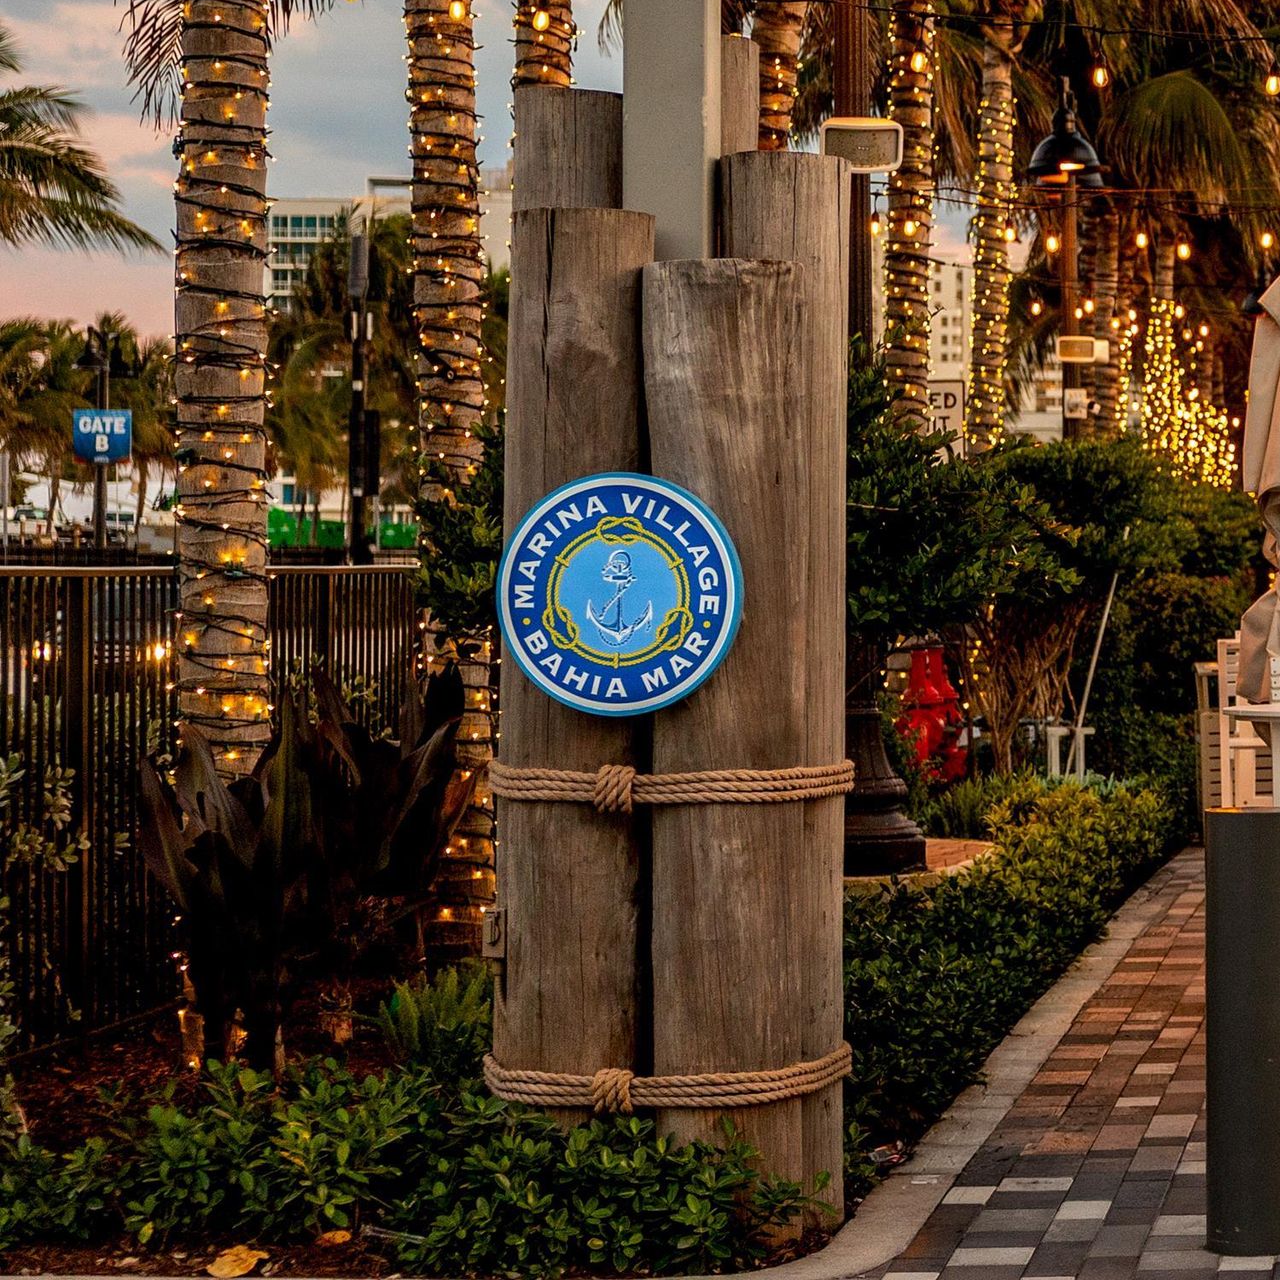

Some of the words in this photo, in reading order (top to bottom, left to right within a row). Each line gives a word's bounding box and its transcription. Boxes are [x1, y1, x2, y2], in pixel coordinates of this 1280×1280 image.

[79, 416, 126, 434] GATE
[95, 434, 109, 452] B
[514, 495, 608, 609] MARINA
[621, 493, 720, 615] VILLAGE
[523, 629, 628, 698] BAHIA
[640, 631, 710, 693] MAR
